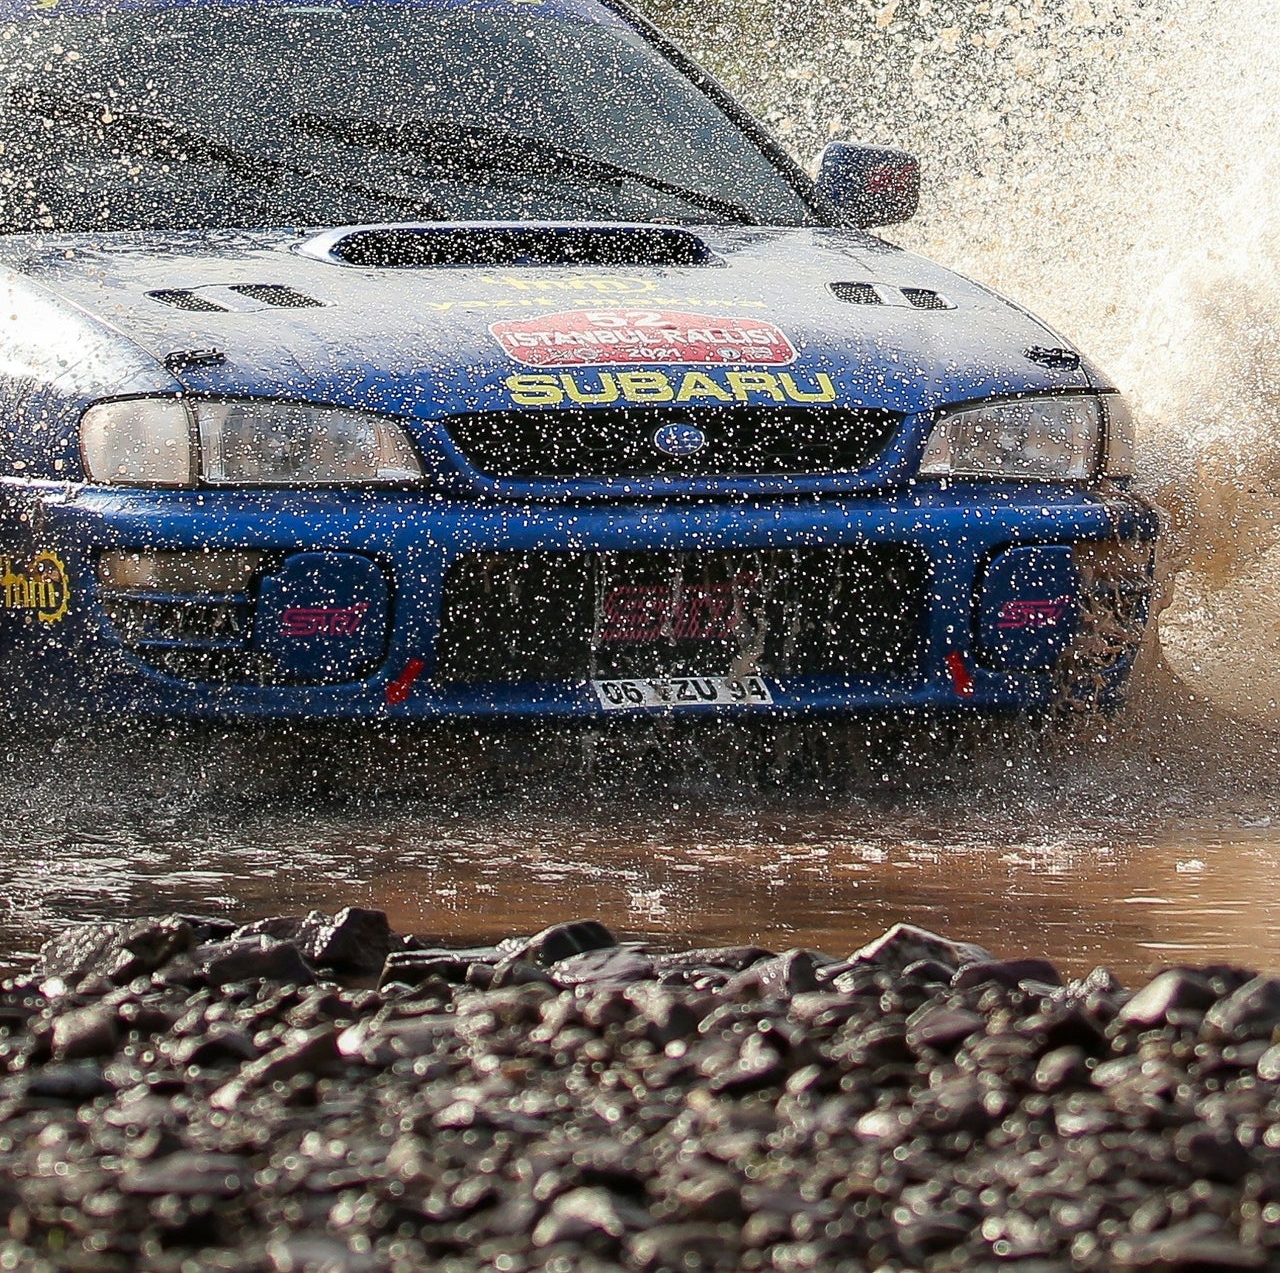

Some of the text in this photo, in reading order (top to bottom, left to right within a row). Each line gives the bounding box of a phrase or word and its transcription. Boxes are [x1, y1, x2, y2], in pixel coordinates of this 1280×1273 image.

[584, 311, 673, 328] 52
[505, 371, 836, 406] SUBARU
[601, 681, 644, 705] 06
